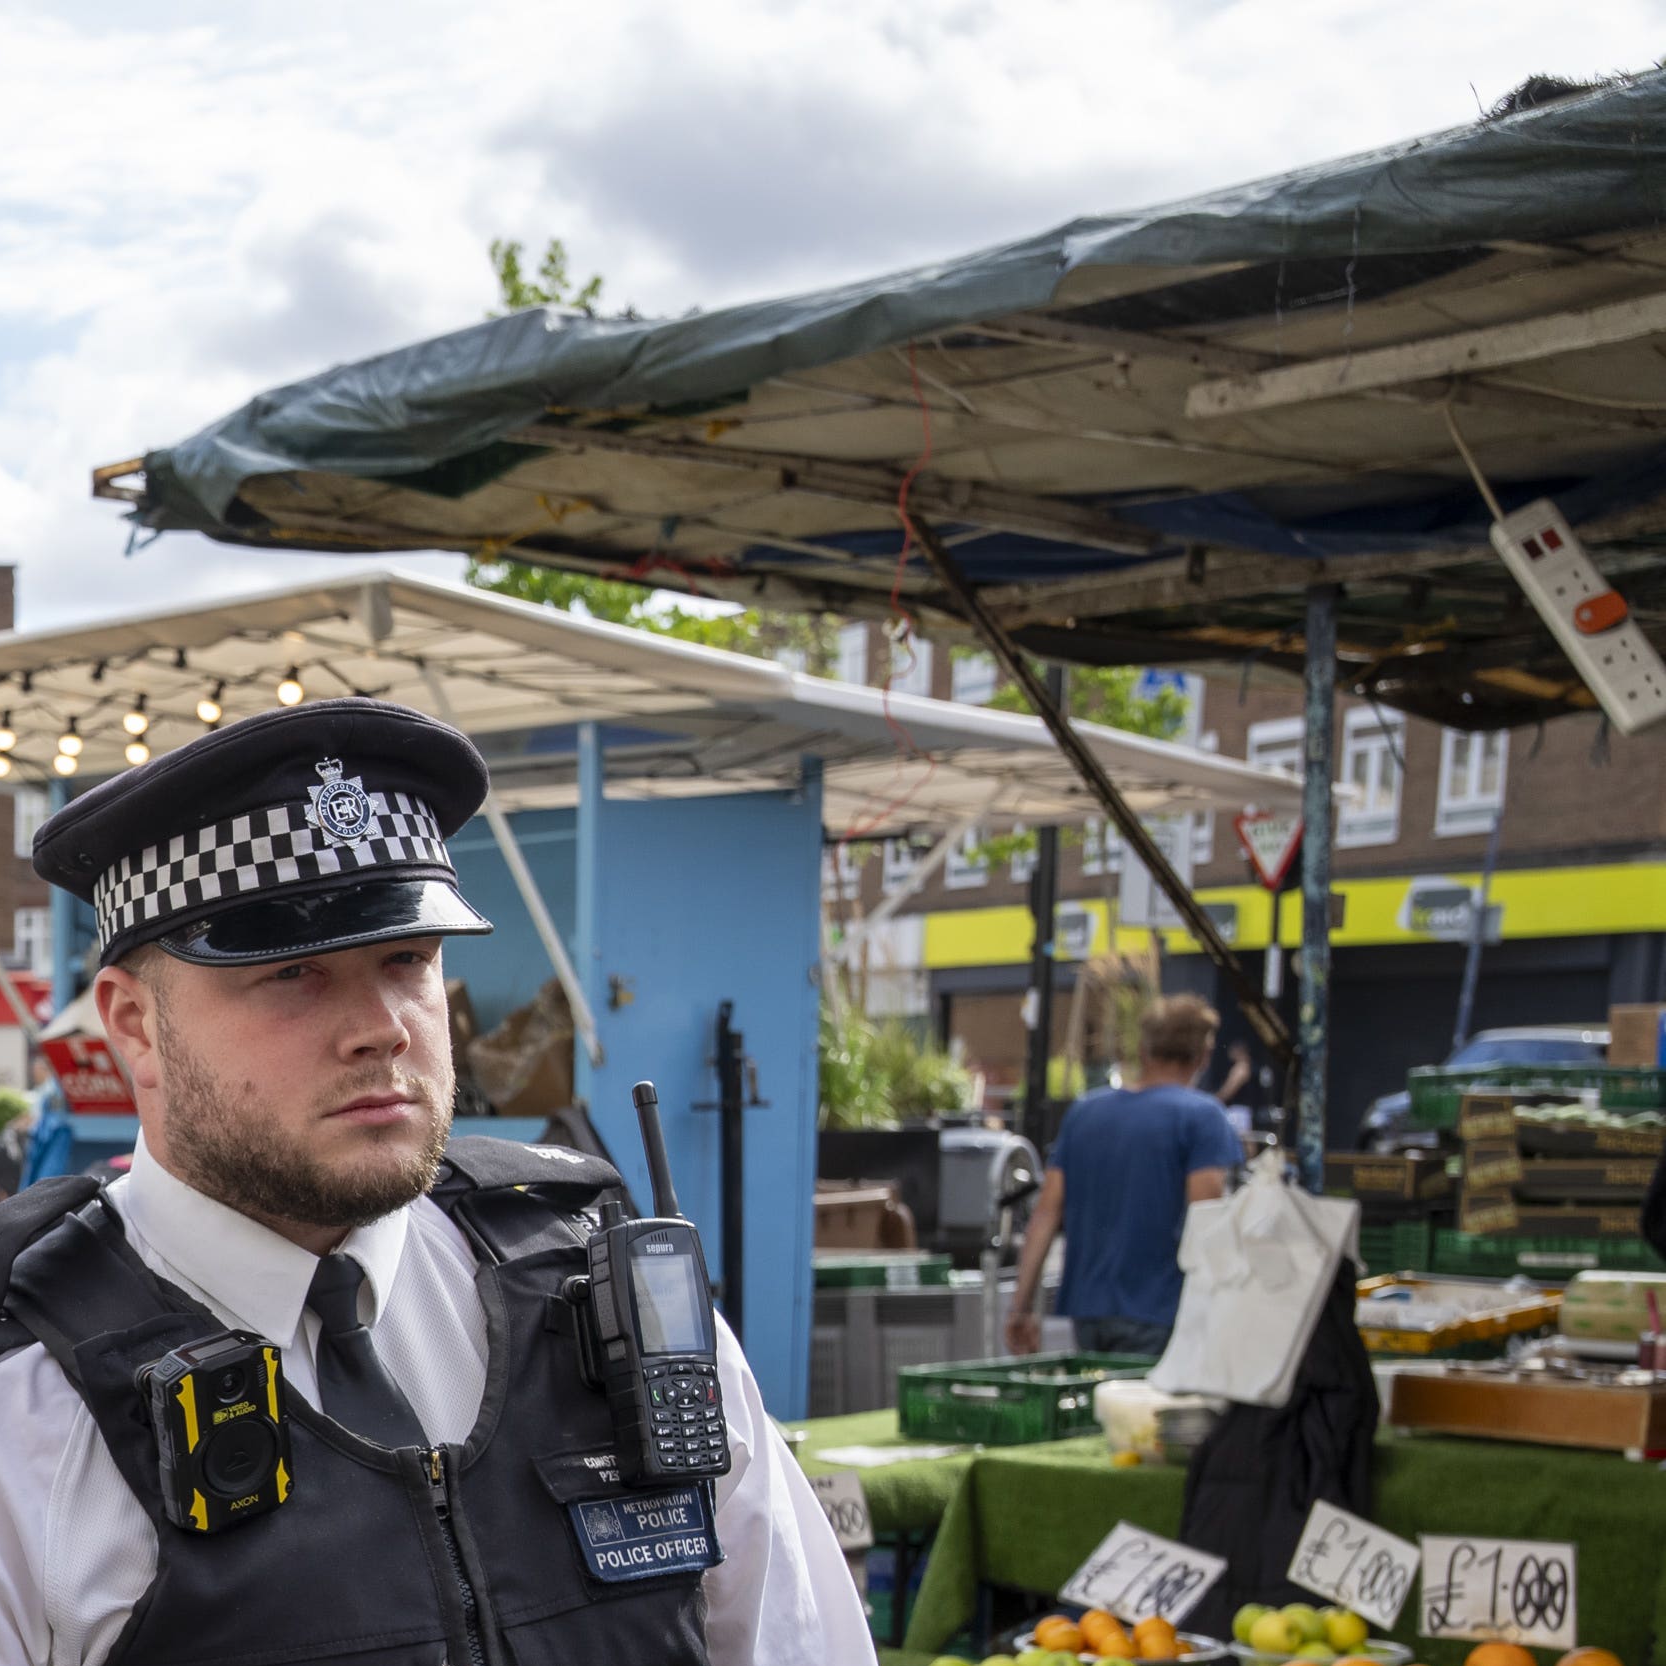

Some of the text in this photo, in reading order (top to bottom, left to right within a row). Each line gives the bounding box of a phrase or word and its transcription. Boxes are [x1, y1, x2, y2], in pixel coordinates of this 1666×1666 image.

[646, 1243, 674, 1254] sepura
[228, 1401, 250, 1413] VIDEO
[235, 1404, 257, 1417] AUDIO
[584, 1455, 617, 1470] CONST
[230, 1494, 260, 1511] AXON
[622, 1493, 693, 1514] METROPOLITAN
[636, 1507, 688, 1531] POLICE
[595, 1537, 709, 1570] POLICE OFFICER
